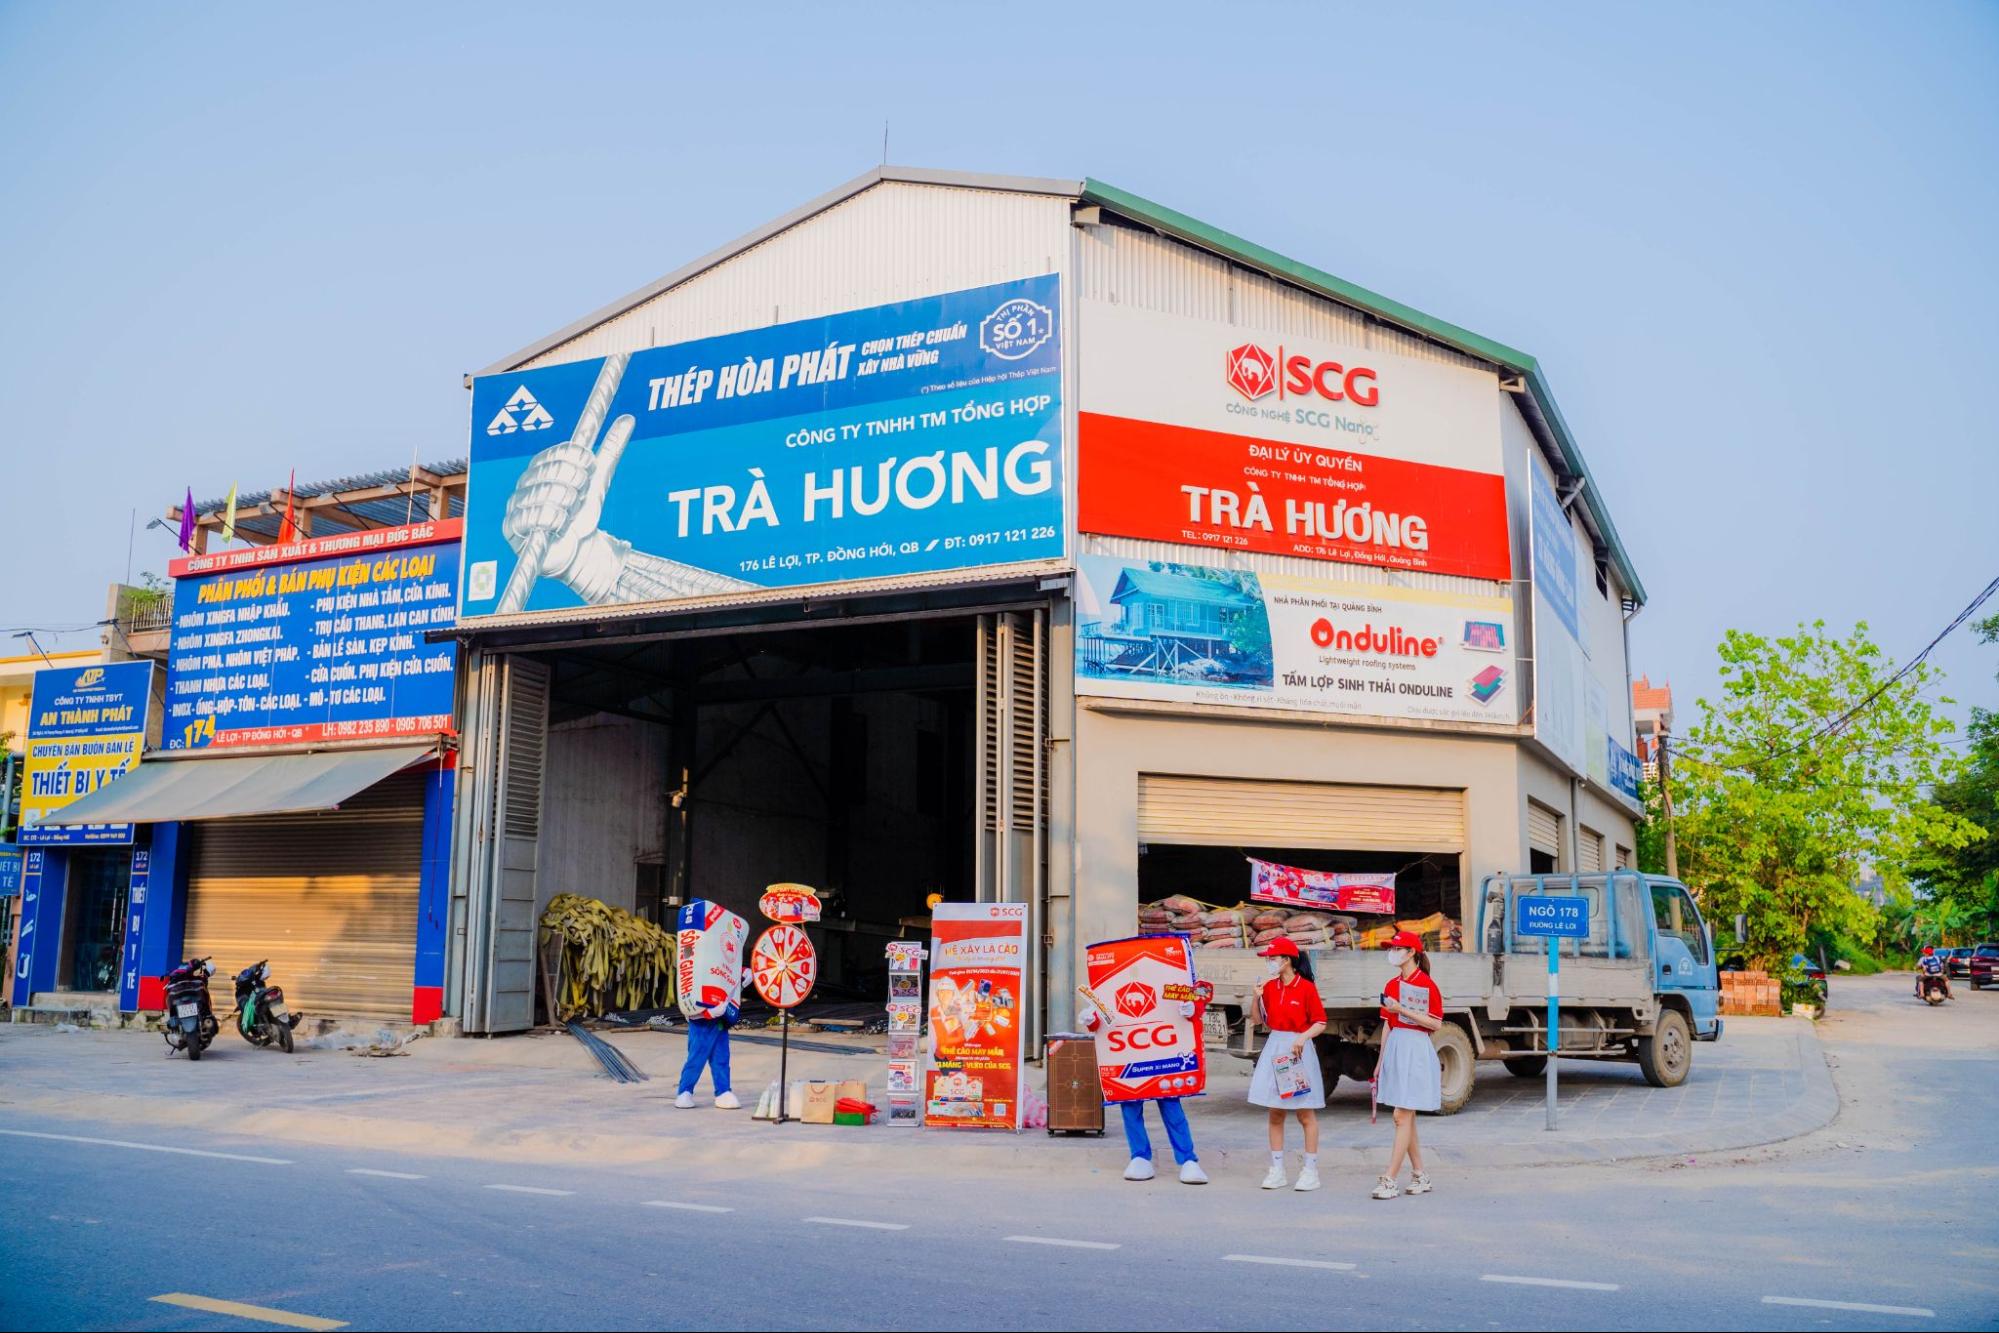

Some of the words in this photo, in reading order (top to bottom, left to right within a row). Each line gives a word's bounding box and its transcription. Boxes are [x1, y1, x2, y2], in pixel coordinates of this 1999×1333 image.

[861, 339, 894, 356] CHỌN
[895, 329, 924, 351] THÉP
[926, 321, 968, 345] CHUẨN
[993, 313, 1022, 341] SỐ
[1016, 337, 1036, 346] NAM
[648, 366, 714, 411] THÉP
[716, 356, 774, 400] HÒA
[779, 341, 856, 389] PHÁT
[857, 359, 879, 376] XÂY
[880, 353, 904, 372] NHÀ
[907, 349, 939, 369] VỮNG
[1286, 355, 1379, 407] SCG
[785, 428, 836, 448] CÔNG
[840, 423, 861, 440] TY
[865, 416, 915, 436] TNHH
[919, 411, 946, 428] TM
[951, 400, 1005, 423] TỔNG
[1010, 394, 1051, 417] HỢP
[1226, 402, 1258, 417] CÔNG
[1261, 408, 1291, 424] NGHỆ
[1295, 408, 1330, 429] SCG
[1335, 416, 1374, 436] Nano
[1248, 444, 1272, 461] ĐẠI
[1275, 446, 1289, 462] LÝ
[1293, 448, 1312, 464] ỦY
[668, 467, 780, 538] TRÀ
[803, 440, 1051, 522] HƯƠNG
[1243, 466, 1268, 477] CÔNG
[1271, 470, 1281, 479] TY
[1284, 472, 1306, 482] TNHH
[1309, 475, 1322, 485] TM
[1180, 481, 1274, 533] TRÀ
[1285, 498, 1429, 551] HƯƠNG
[739, 560, 759, 572] 176
[762, 555, 775, 569] LÊ
[805, 552, 824, 565] TP.
[827, 546, 866, 562] ĐỒNG
[900, 542, 919, 554] QB
[944, 536, 966, 549] ĐT:
[968, 532, 1000, 546] 0917
[1004, 529, 1026, 542] 121
[1031, 526, 1055, 539] 226
[1202, 532, 1221, 542] 0917
[187, 558, 213, 571] CÔNG
[216, 555, 227, 567] TY
[230, 552, 255, 565] TNHH
[309, 545, 317, 554] &
[362, 533, 384, 548] MẠI
[233, 569, 265, 599] PHỐI
[265, 575, 277, 596] &
[278, 567, 308, 594] BÁN
[307, 567, 337, 594] PHỤ
[372, 554, 400, 582] CÁC
[400, 554, 436, 582] LOẠI
[1274, 596, 1289, 605] NHÀ
[1310, 617, 1438, 658] Onduline
[1319, 655, 1360, 667] Lightweight
[1362, 658, 1386, 670] roofing
[1388, 661, 1416, 671] systems
[228, 672, 245, 690] CÁC
[1282, 670, 1307, 687] TẤM
[1310, 674, 1334, 691] LỢP
[1338, 678, 1365, 692] SINH
[1368, 678, 1395, 694] THÁI
[1399, 682, 1453, 698] ONDULINE
[75, 696, 85, 705] TY
[40, 712, 58, 726] AN
[60, 708, 99, 725] THÀNH
[101, 704, 134, 722] PHÁT
[32, 761, 72, 796] THIẾT
[29, 852, 41, 862] 172
[135, 852, 149, 861] 172
[1002, 908, 1022, 916] SCG
[1529, 905, 1555, 918] NGÕ
[1560, 907, 1579, 918] 178
[1107, 1024, 1178, 1052] SCG
[1132, 1064, 1154, 1073] SUPER
